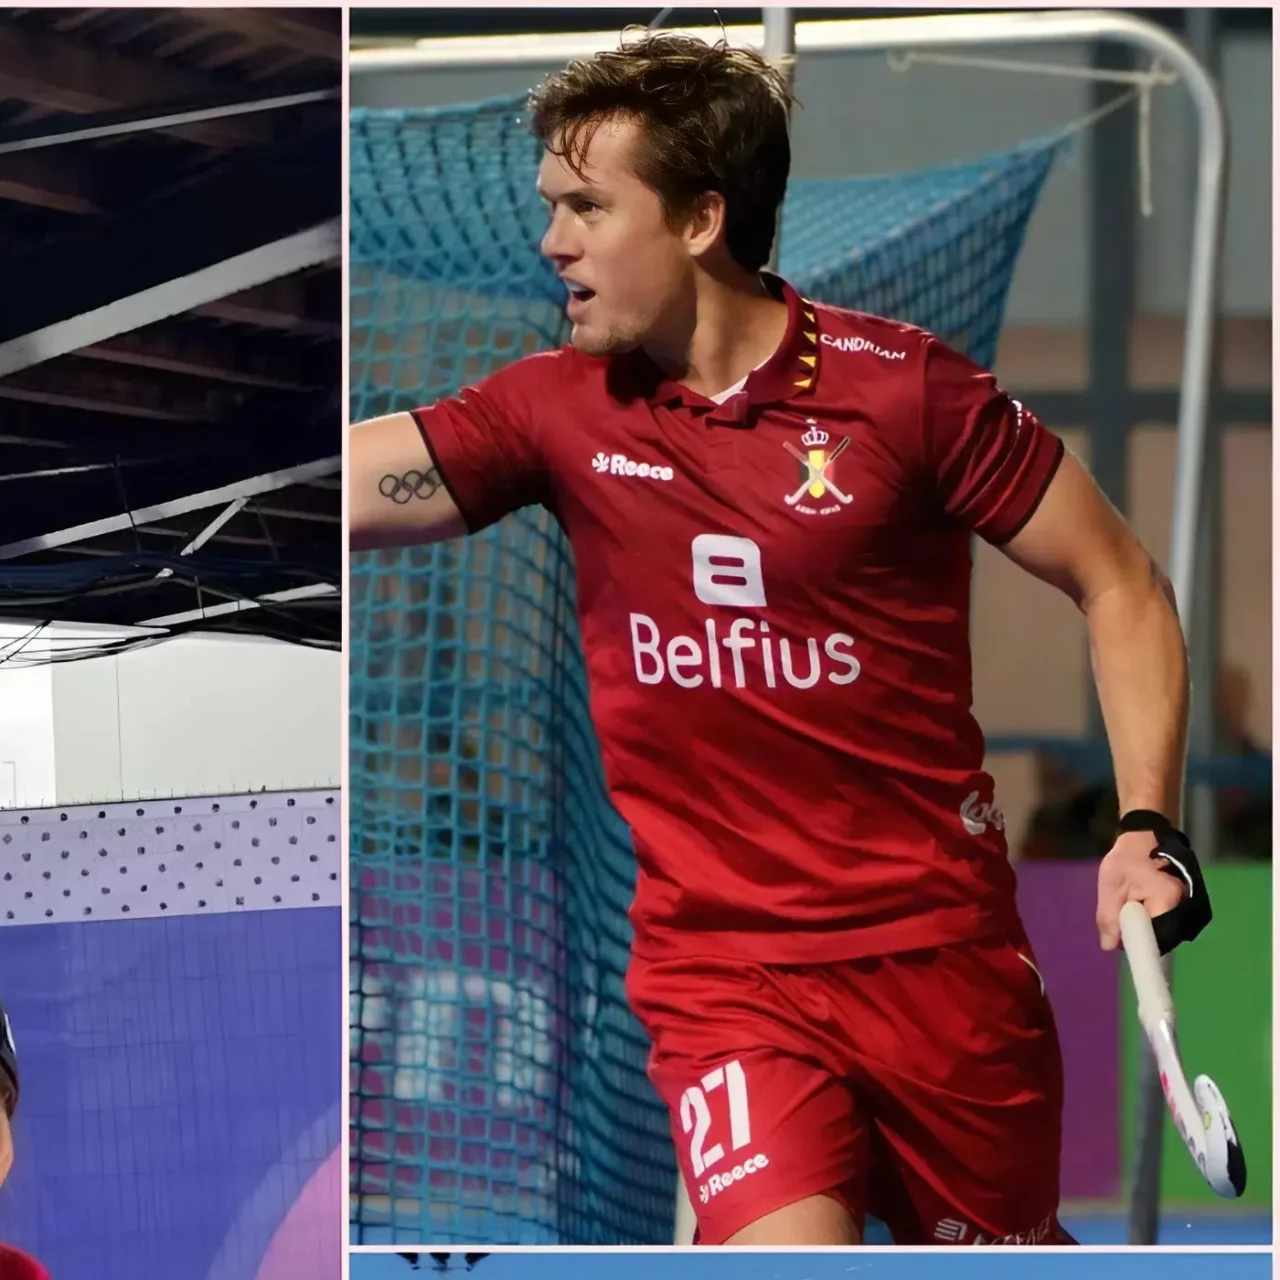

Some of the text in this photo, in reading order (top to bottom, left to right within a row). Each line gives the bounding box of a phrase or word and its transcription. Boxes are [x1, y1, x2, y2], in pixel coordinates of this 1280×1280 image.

[609, 454, 674, 481] Reece
[629, 612, 861, 689] Belfius
[679, 1059, 751, 1179] 27
[708, 1153, 769, 1197] Reece
